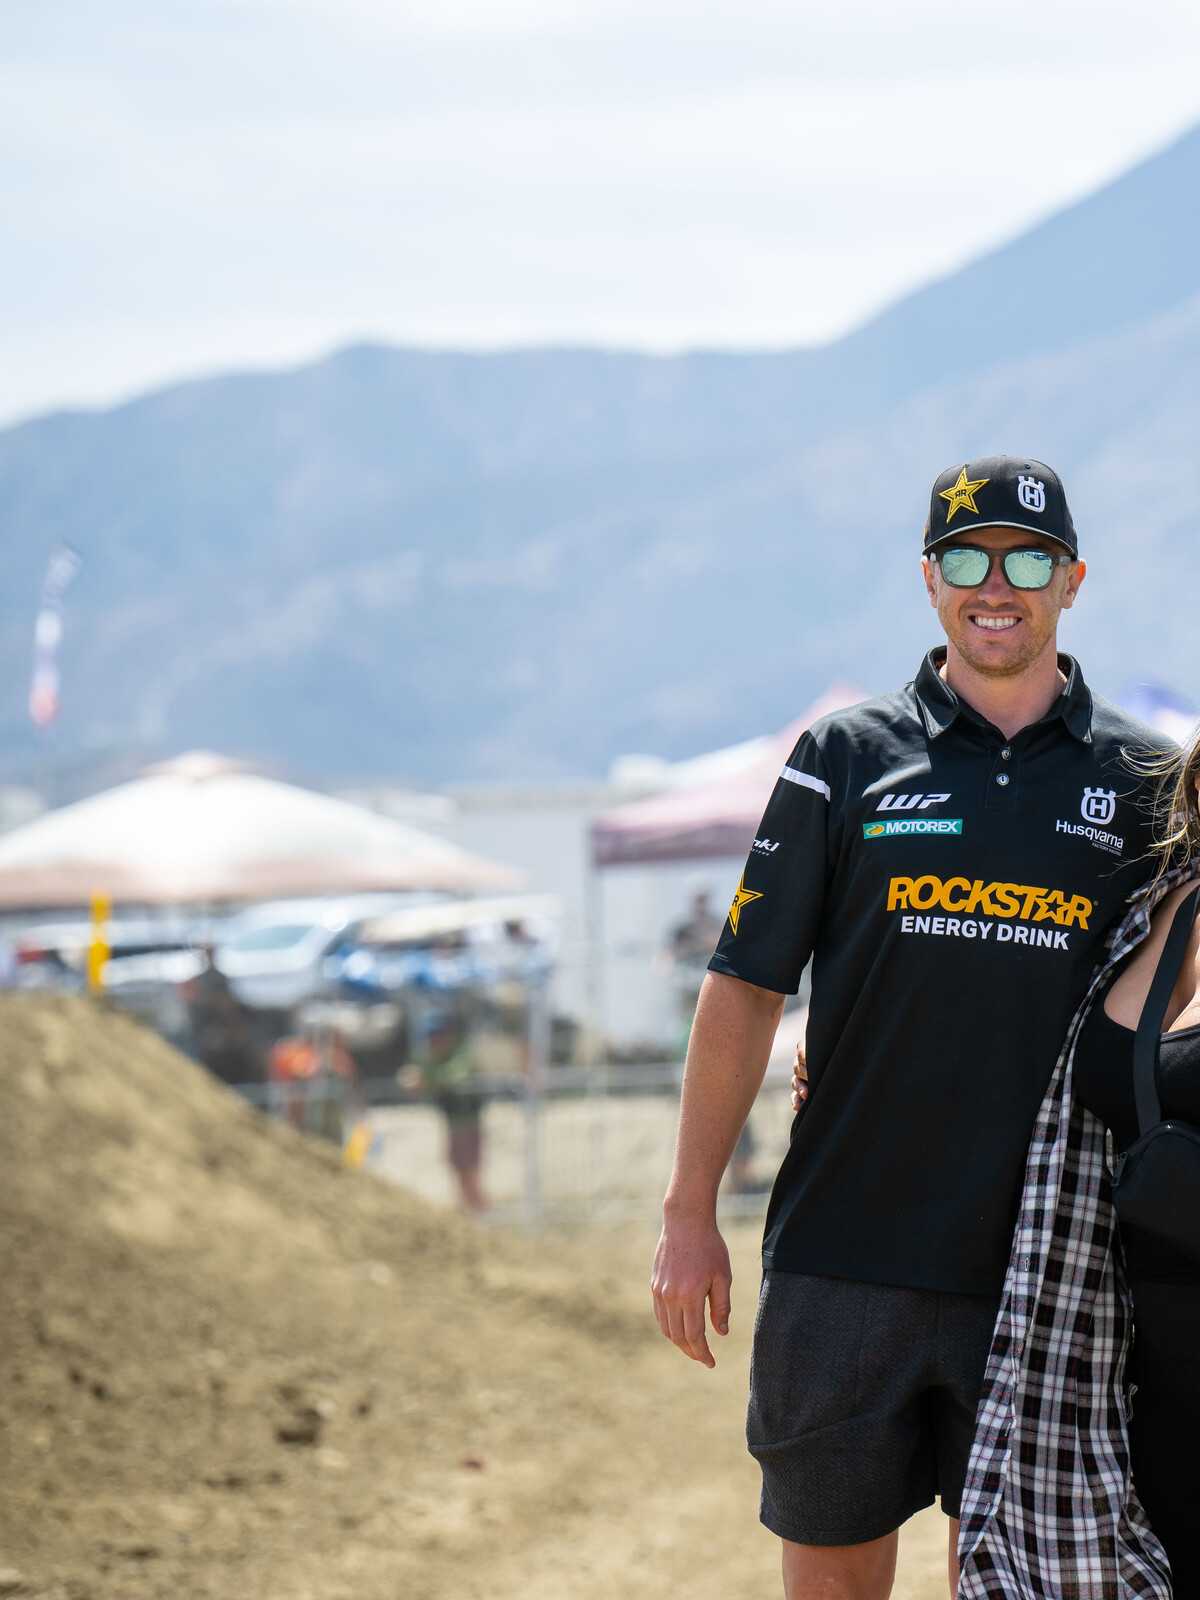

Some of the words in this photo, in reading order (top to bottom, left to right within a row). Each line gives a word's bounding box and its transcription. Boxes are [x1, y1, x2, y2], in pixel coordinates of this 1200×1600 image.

[875, 793, 952, 811] WP
[886, 821, 958, 834] MOTOREX
[1055, 819, 1124, 849] Husqvarna
[886, 875, 1093, 930] ROCKSTAR
[901, 915, 994, 940] ENERGY
[996, 923, 1070, 950] DRINK
